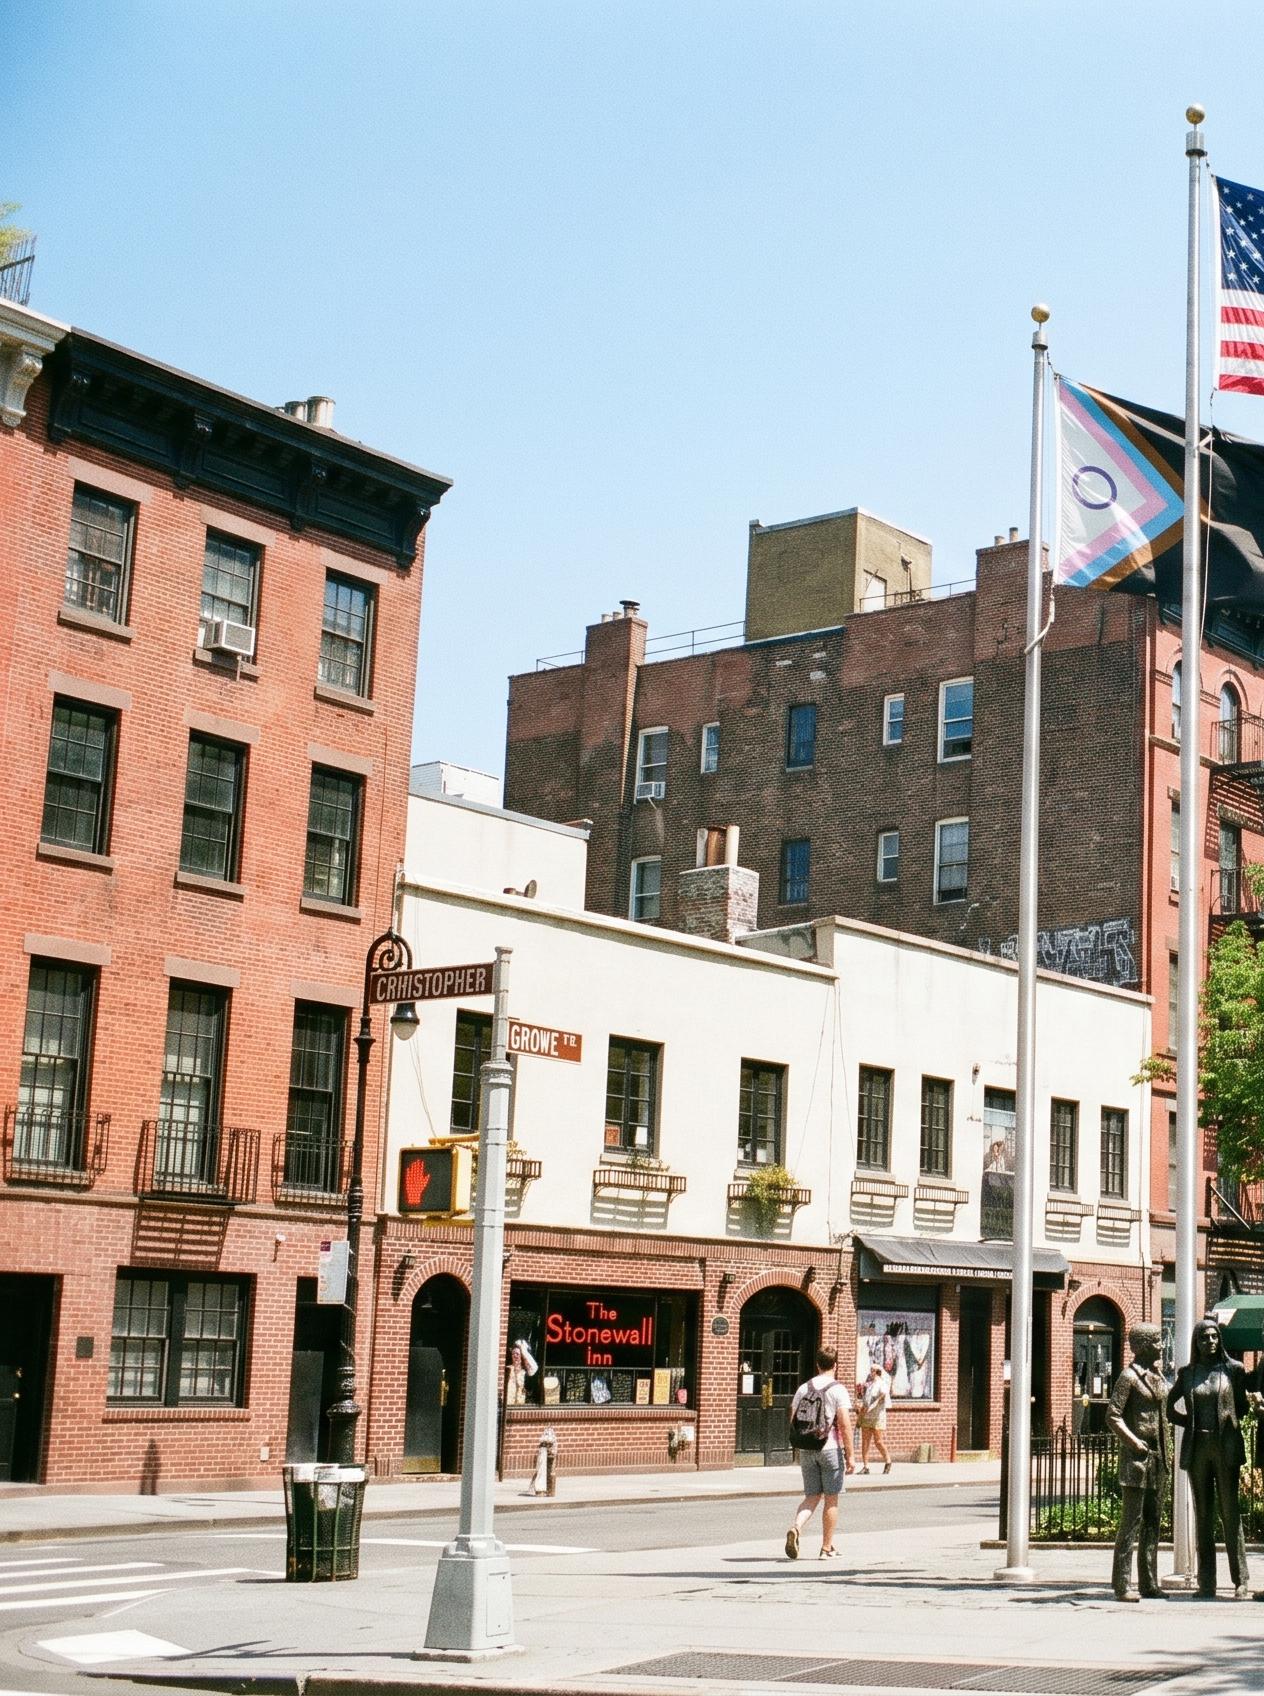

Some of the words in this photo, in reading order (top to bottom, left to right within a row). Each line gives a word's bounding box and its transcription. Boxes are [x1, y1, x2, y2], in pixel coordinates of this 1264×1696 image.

[376, 967, 487, 1001] CRHISTOPHER
[511, 1024, 559, 1056] GROWE
[586, 1302, 617, 1320] The
[546, 1314, 653, 1345] Stonewall
